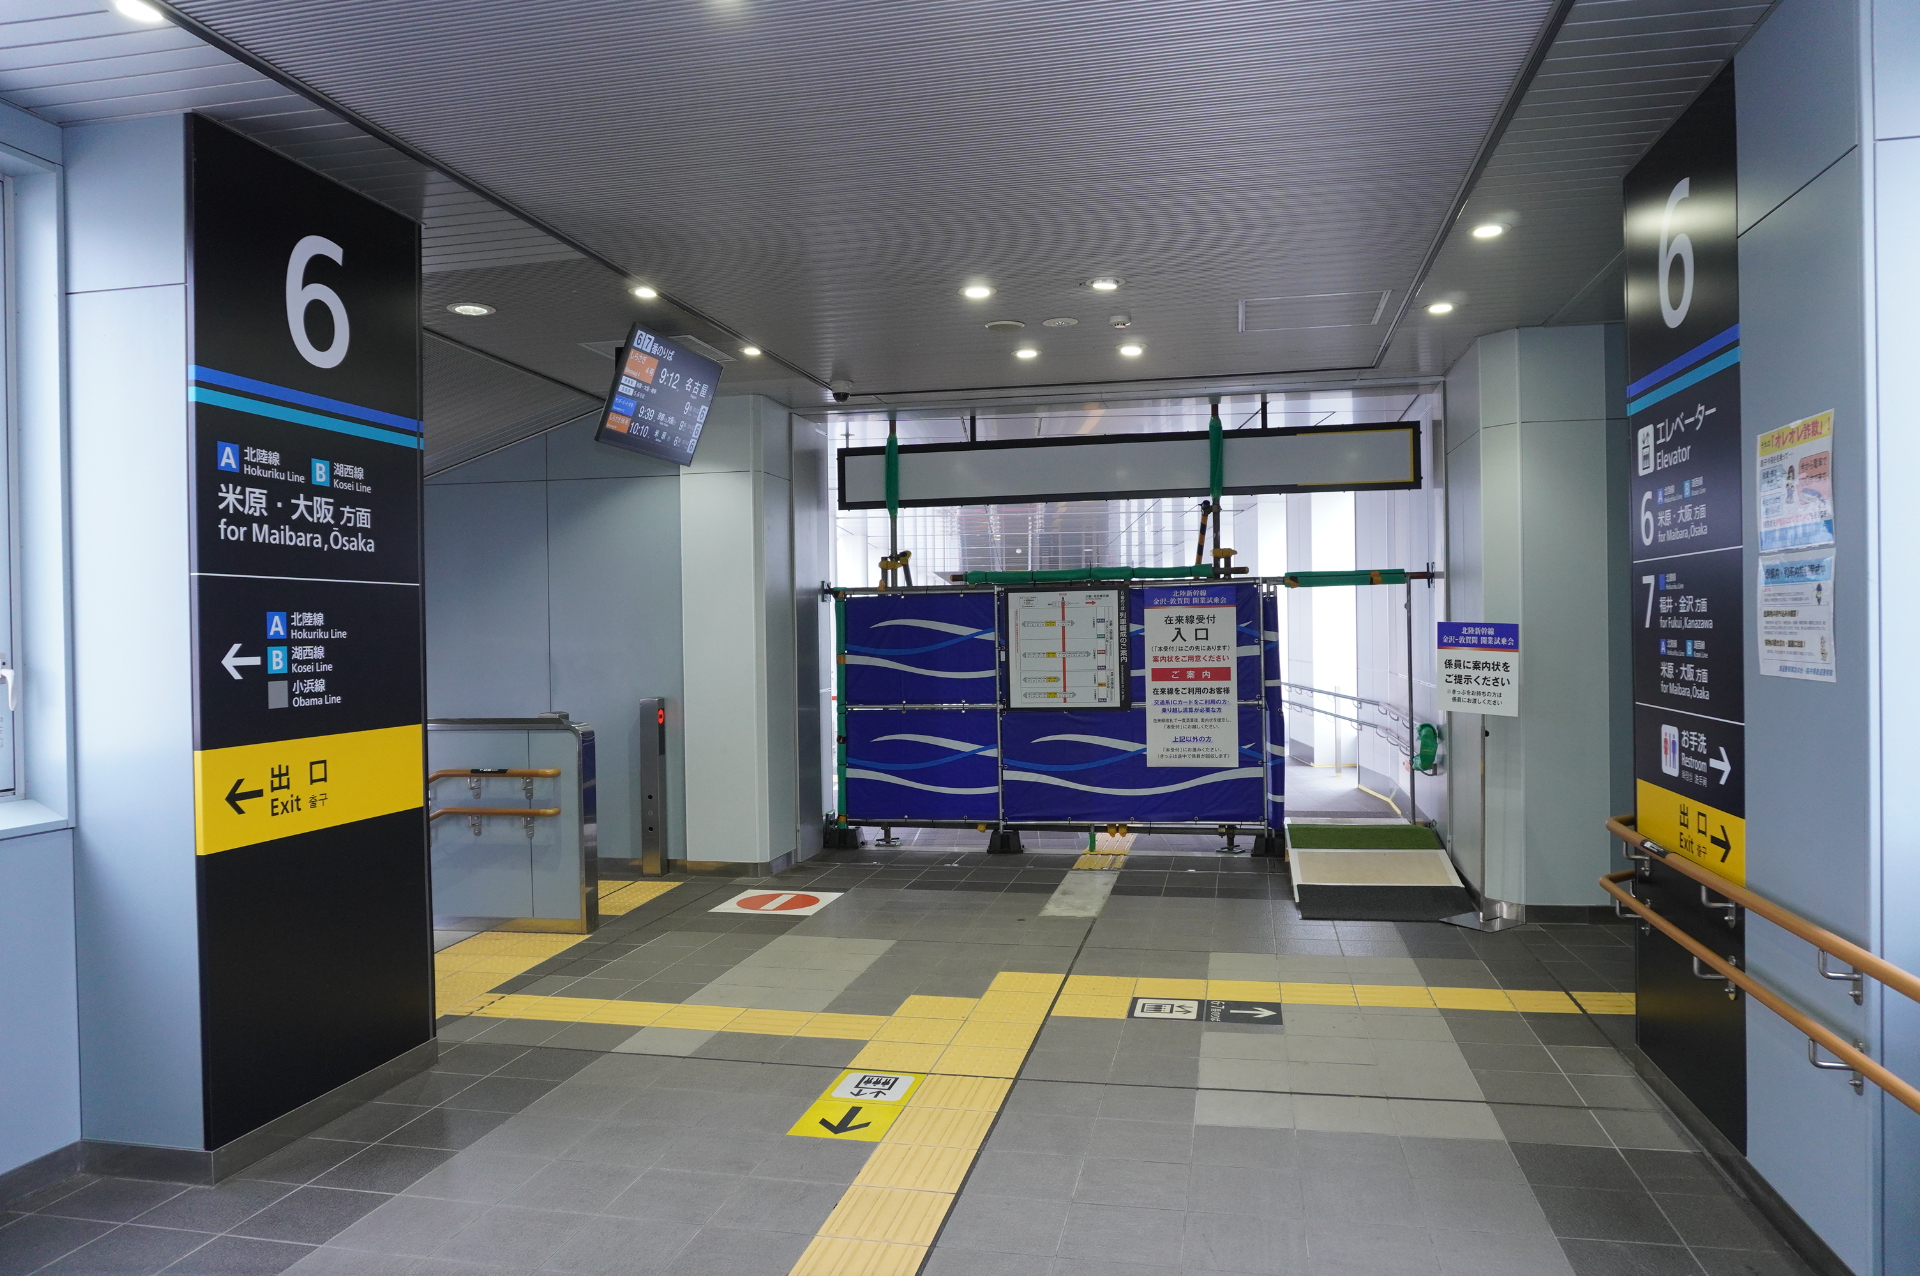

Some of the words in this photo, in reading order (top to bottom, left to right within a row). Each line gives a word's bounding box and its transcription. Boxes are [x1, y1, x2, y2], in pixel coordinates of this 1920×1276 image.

[1658, 177, 1694, 329] 6
[285, 234, 350, 369] 6
[651, 342, 675, 361] 番のりば
[659, 368, 680, 390] 9:12
[685, 377, 709, 398] 名古屋
[638, 405, 655, 421] 9:39
[684, 402, 691, 415] 9
[629, 422, 649, 438] 10:10
[678, 420, 685, 431] 9
[1656, 403, 1717, 444] エレベーター
[220, 447, 236, 468] A
[244, 446, 280, 466] 北陸線
[1656, 445, 1692, 471] Elevator
[244, 464, 285, 481] Hokuriku
[287, 472, 305, 483] Line
[316, 463, 326, 482] B
[333, 463, 364, 480] 湖西線
[334, 479, 354, 491] Kosei
[356, 482, 371, 494] Line
[1684, 482, 1690, 496] B
[1658, 493, 1663, 503] A
[340, 505, 371, 528] 方面
[1641, 490, 1655, 546] 6
[1693, 504, 1706, 523] 方面
[218, 518, 247, 542] for
[1658, 530, 1666, 543] for
[1173, 589, 1207, 597] 北陸新幹線
[1642, 575, 1655, 629] 7
[1695, 598, 1707, 613] 方面
[269, 615, 285, 636] A
[291, 612, 324, 627] 北陸線
[1164, 614, 1216, 625] 在来線受付
[1660, 616, 1668, 628] for
[291, 629, 328, 639] Hokuriku
[331, 629, 347, 639] Line
[1171, 627, 1209, 642] 入口
[1462, 626, 1495, 636] 北陸新幹線
[291, 646, 325, 660] 湖西線
[1661, 641, 1666, 653] A
[1687, 642, 1692, 655] B
[272, 650, 283, 670] B
[1152, 655, 1230, 663] 案内状をご用意ください
[1444, 659, 1510, 673] 係員に案内状を
[291, 663, 314, 673] Kosei
[316, 662, 333, 672] Line
[1172, 670, 1211, 679] ご案内
[1696, 668, 1708, 683] 方面
[292, 678, 325, 694] 小浜線
[1445, 673, 1510, 687] ご提示ください
[1152, 687, 1231, 695] 在来線をご利用のお客様
[292, 696, 323, 708] Obama
[324, 694, 341, 705] Line
[1451, 696, 1503, 706] 係員にお渡しください
[1681, 729, 1707, 755] お手洗
[1681, 752, 1707, 773] Restroom
[271, 759, 327, 793] 出口
[271, 794, 301, 817] Exit
[308, 793, 328, 809] 출구
[1680, 803, 1707, 837] 出口
[1679, 832, 1694, 854] Exit
